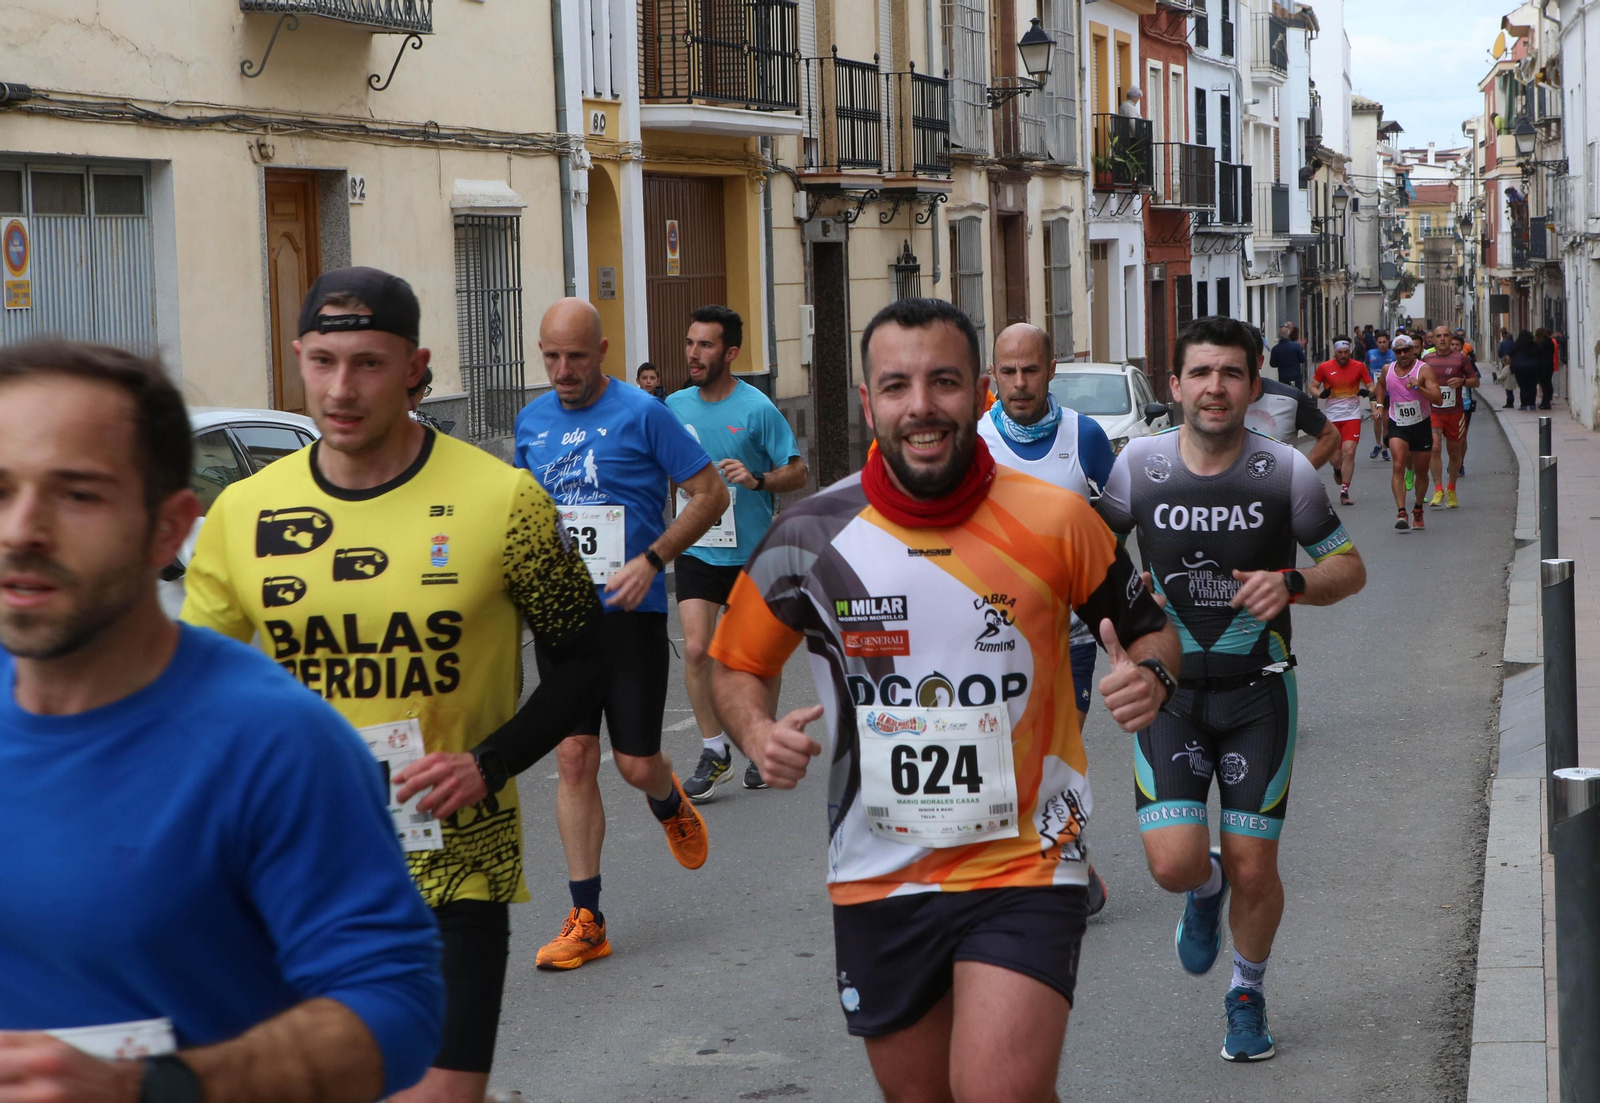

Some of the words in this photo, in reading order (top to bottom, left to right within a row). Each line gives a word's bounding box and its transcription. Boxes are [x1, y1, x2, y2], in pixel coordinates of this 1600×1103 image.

[351, 177, 365, 200] 62
[1400, 407, 1416, 418] 490
[561, 427, 586, 446] edp
[557, 450, 582, 467] edp
[1154, 501, 1264, 532] CORPAS
[1188, 570, 1213, 580] CLUB
[973, 593, 1017, 610] CABRA
[1188, 589, 1195, 598] Y
[851, 598, 904, 616] MILAR
[264, 610, 463, 659] BALAS
[860, 635, 904, 646] GENERALI
[973, 639, 1016, 652] running
[847, 671, 1028, 707] DCOOP
[891, 745, 983, 795] 624
[1223, 811, 1269, 831] REYES
